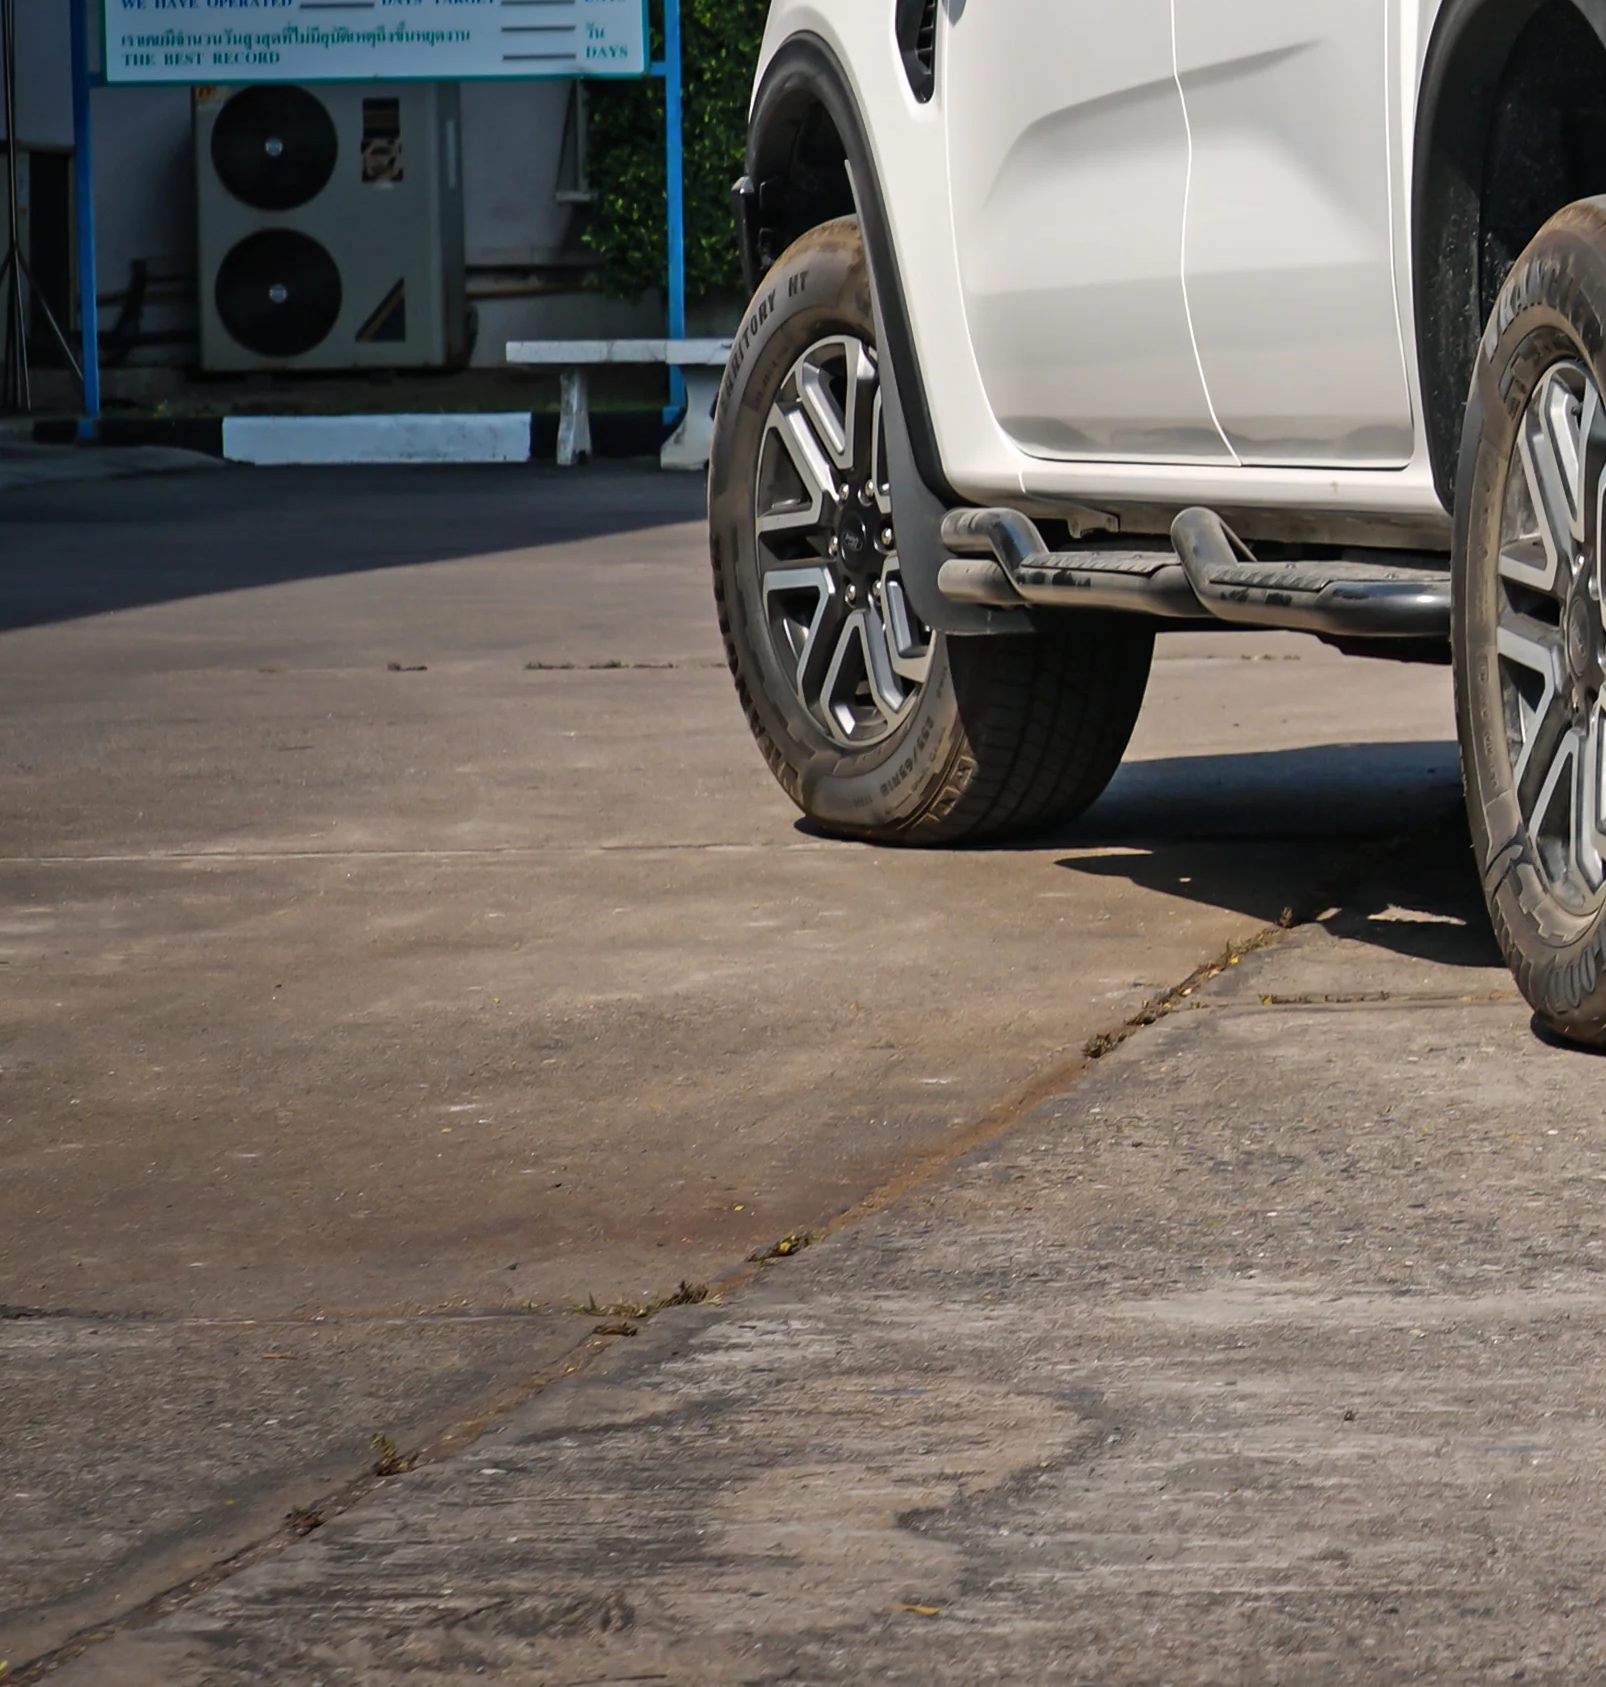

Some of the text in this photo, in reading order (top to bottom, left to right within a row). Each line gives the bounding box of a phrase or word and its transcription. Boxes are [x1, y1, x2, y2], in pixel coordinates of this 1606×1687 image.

[122, 44, 629, 67] THE BEST RECORD DAYS
[788, 270, 809, 298] HT
